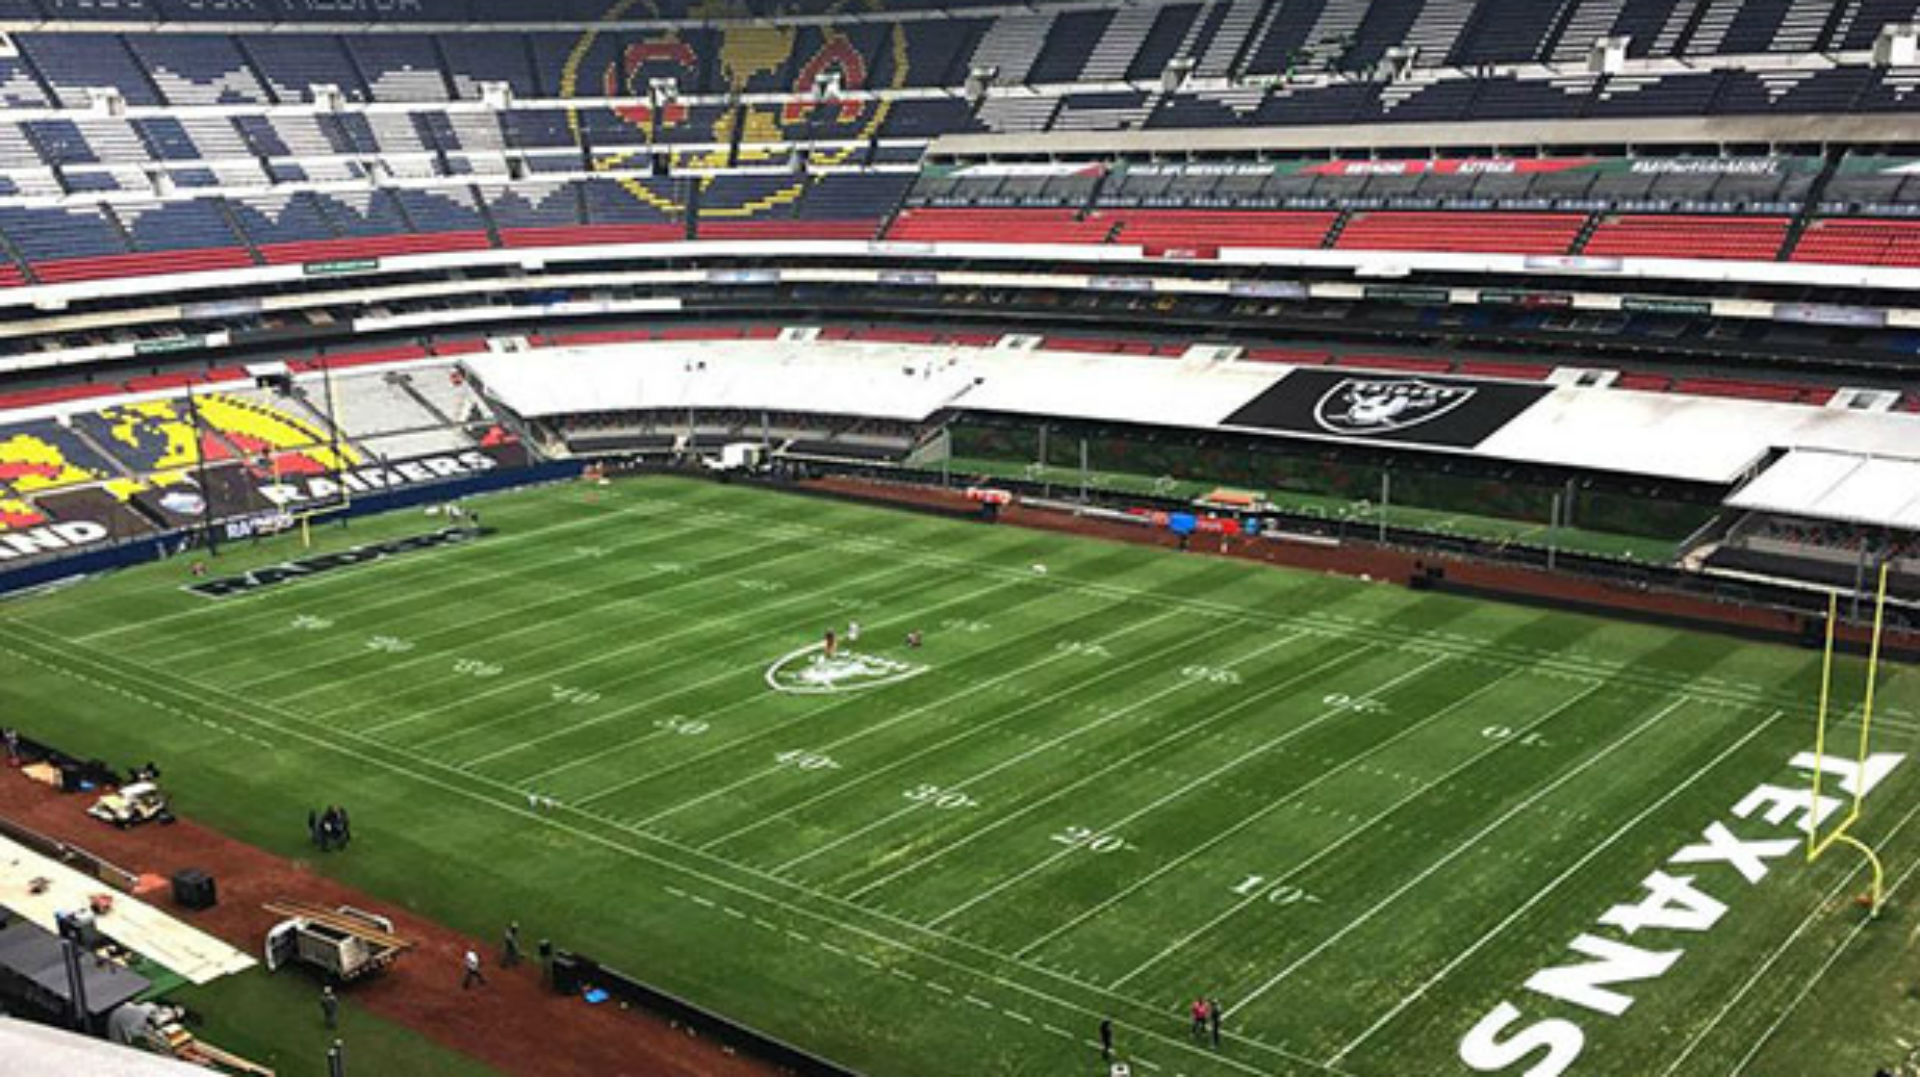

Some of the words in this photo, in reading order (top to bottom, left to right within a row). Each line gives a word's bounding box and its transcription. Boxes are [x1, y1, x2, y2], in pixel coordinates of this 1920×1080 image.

[258, 451, 497, 504] RAIDERS
[1050, 826, 1125, 853] 20
[1229, 874, 1304, 904] 10
[1457, 752, 1906, 1077] TEXANS
